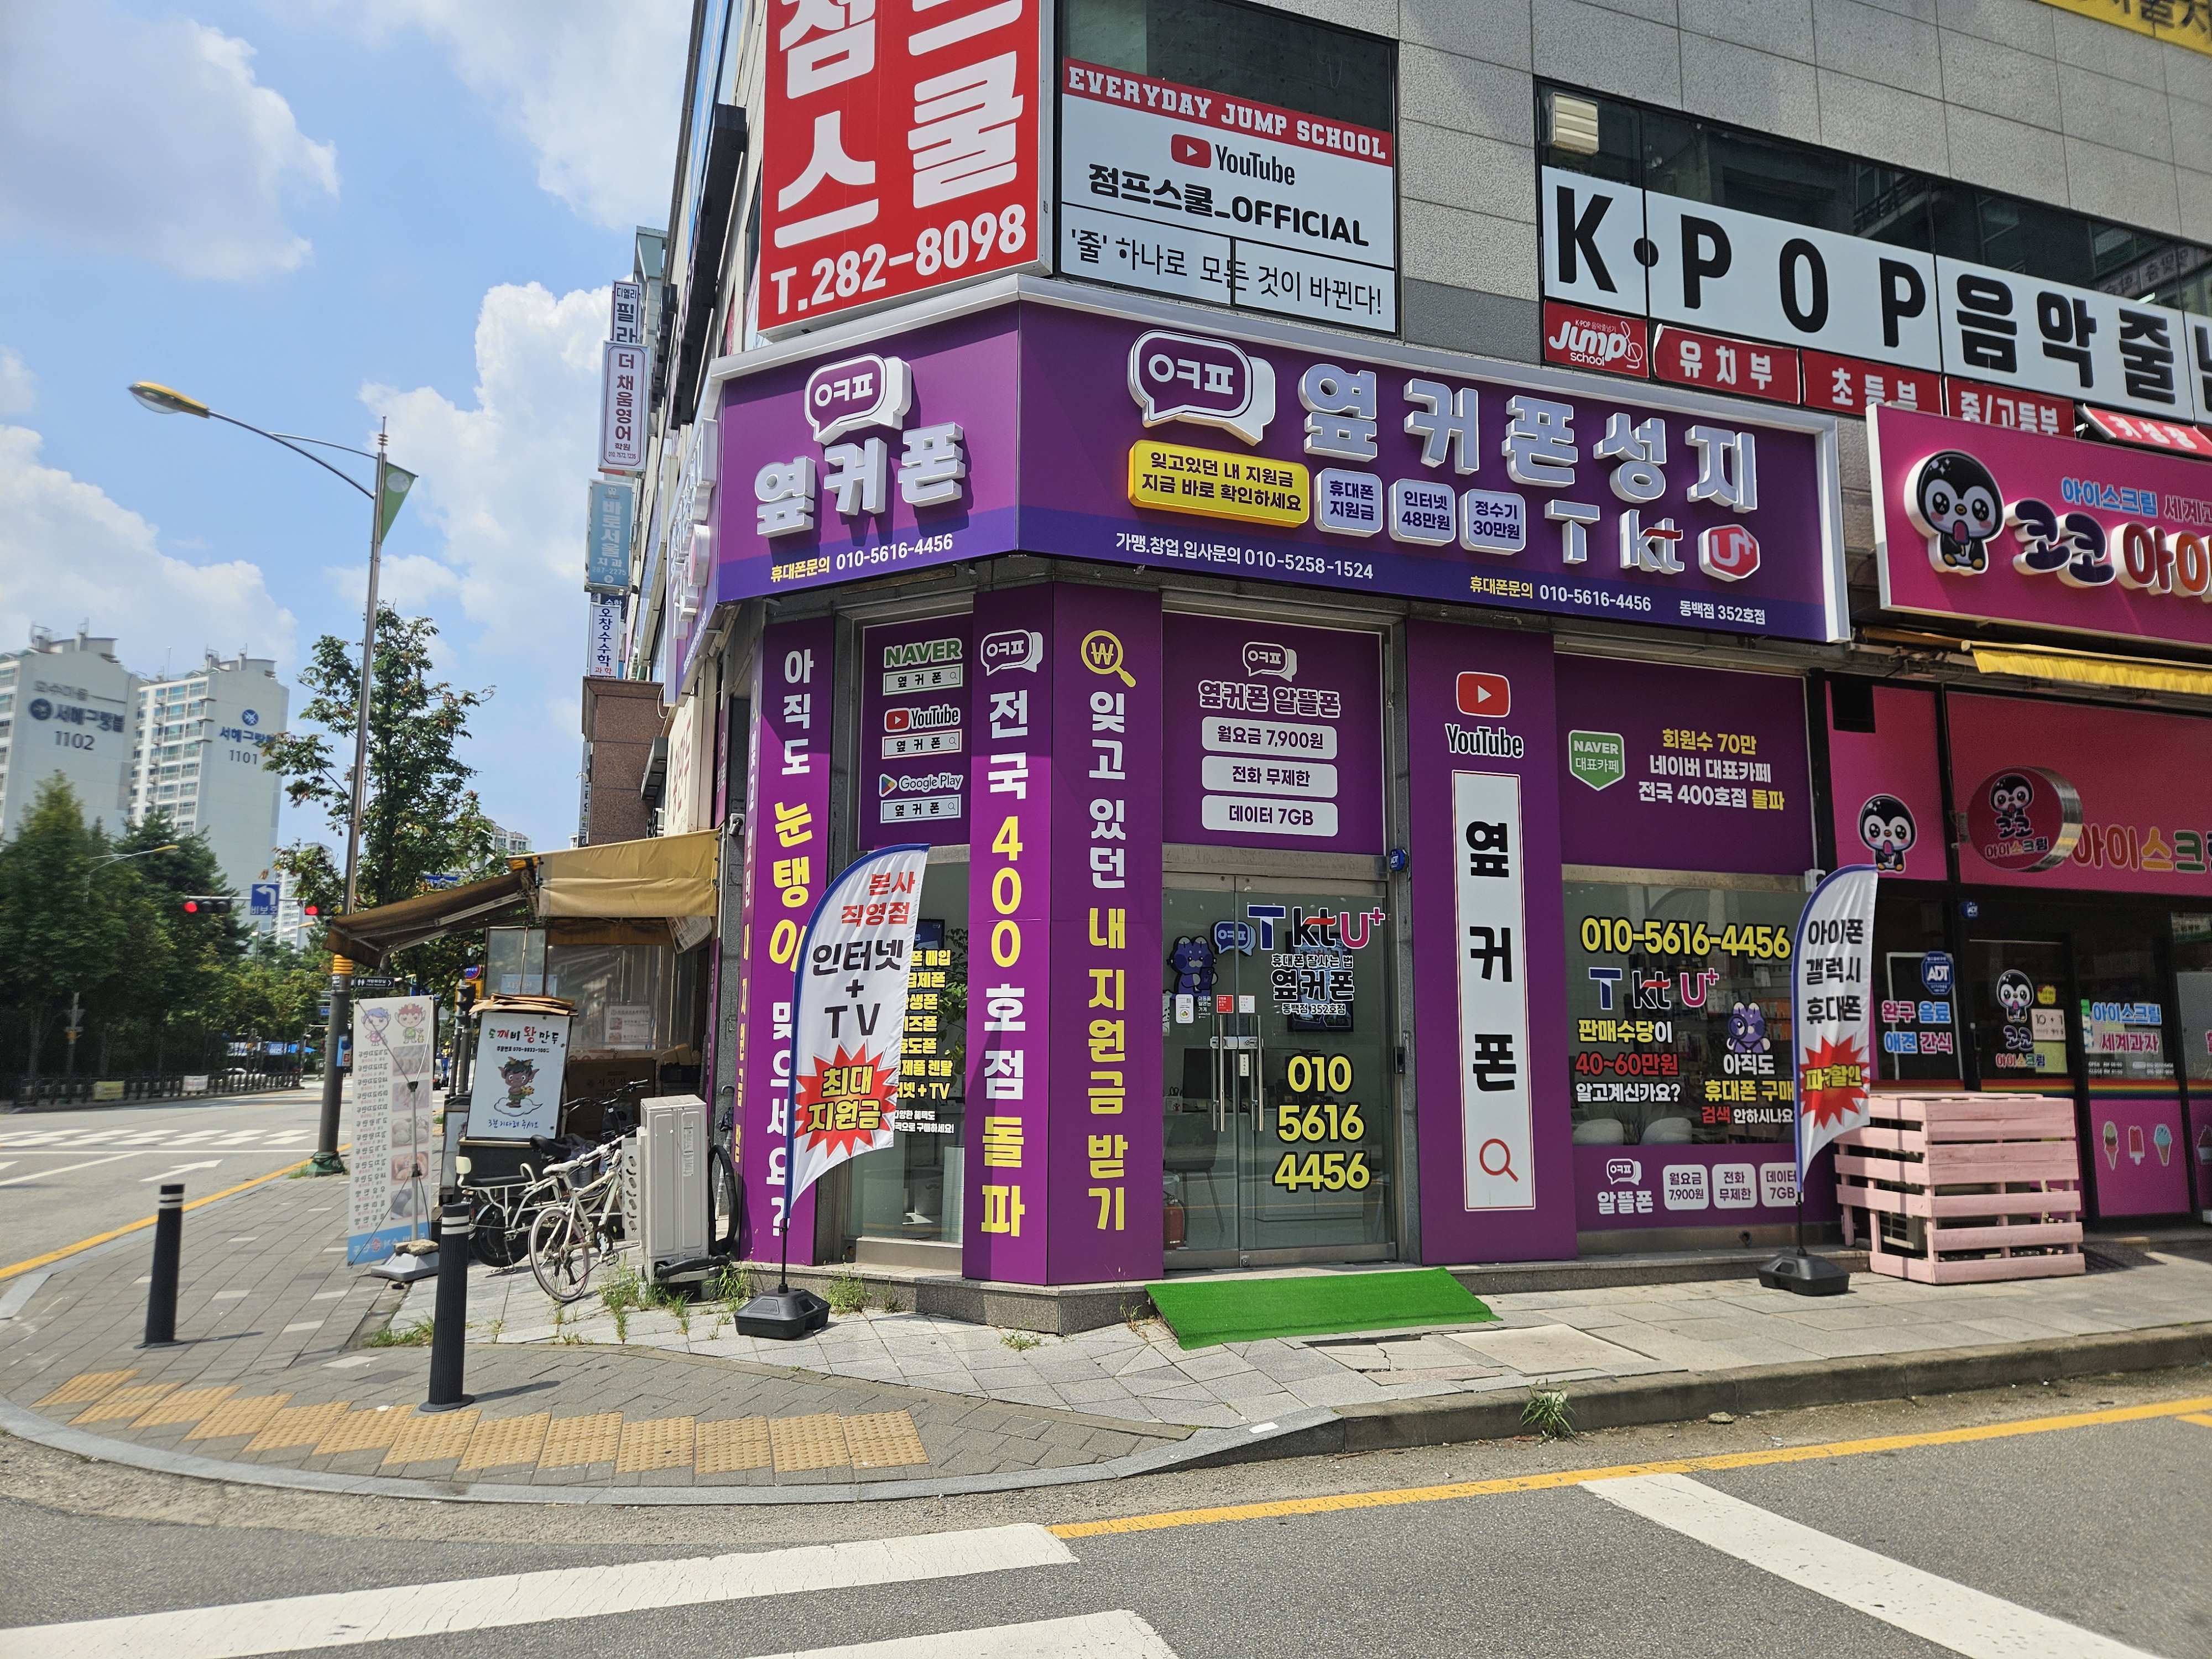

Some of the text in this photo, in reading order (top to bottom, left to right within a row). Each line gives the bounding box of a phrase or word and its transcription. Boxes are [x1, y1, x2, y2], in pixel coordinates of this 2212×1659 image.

[1068, 66, 1386, 159] EVERYDAY JUMP SCHOOL
[1215, 144, 1295, 185] YouTube
[1089, 164, 1369, 246] 점프스쿨_OFFICIAL
[771, 205, 1026, 315] T.282-8098
[1071, 229, 1382, 315] '줄' 하나로 모든 것이 바뀐다!
[1548, 321, 1626, 361] Jump
[1570, 352, 1605, 366] school
[1680, 340, 1917, 410] 유치부 초등부
[615, 353, 634, 441] 더 채움영어
[1961, 391, 2059, 435] 중/고등부
[1150, 451, 1293, 488] 잊고있던 내 지원금
[1142, 472, 1302, 513] 지금 바로 확인하세요
[1329, 481, 1374, 499] 휴대폰
[1404, 489, 1447, 510] 인터넷
[2062, 477, 2158, 518] 아이스크림
[1329, 502, 1374, 521] 지원금
[1401, 511, 1451, 531] 48만원
[1475, 499, 1518, 520] 정수기
[601, 500, 622, 557] 바로서울
[1473, 520, 1520, 540] 30만원
[1545, 499, 1600, 564] T
[1620, 509, 1685, 575] kt
[597, 559, 622, 568] 치과
[771, 533, 953, 582] 휴대폰문의 010-5616-4456
[1116, 532, 1373, 580] 가맹.창업.입사문의 010-5258-1524
[592, 566, 627, 576] 287-2275
[1470, 576, 1766, 625] 휴대폰문의 010-5616-4456 동백점 352호점
[886, 640, 961, 666] NAVER
[782, 649, 814, 775] 아직도
[1273, 686, 1341, 718] 알뜰폰
[911, 707, 958, 727] YouTube
[54, 731, 95, 750] 1102
[988, 689, 1029, 800] 전국
[1217, 725, 1323, 749] 월요금 7,900원
[1446, 723, 1524, 758] YouTube
[1574, 740, 1619, 754] NAVER
[1663, 728, 1756, 755] 회원수 70만
[230, 750, 258, 765] 1101
[1575, 757, 1619, 773] 대표카페
[1650, 755, 1771, 783] 네이버 대표카페
[900, 774, 961, 790] Google Play
[1232, 765, 1310, 787] 전화 무제한
[1639, 781, 1785, 811] 전국 400호점 돌파
[1229, 805, 1313, 825] 데이터 7GB
[1995, 816, 2033, 839] 코코
[1985, 836, 2048, 859] 아이스크림
[2072, 824, 2212, 873] 아이스크
[769, 802, 812, 973] 눈탱이
[870, 872, 915, 896] 본사
[251, 905, 278, 914] 비보호
[841, 902, 910, 927] 직영점
[1292, 907, 1337, 948] kt
[1582, 917, 1791, 958] 010-5616-4456
[1808, 919, 1864, 946] 아이폰
[813, 940, 903, 975] 인터넷
[925, 950, 951, 966] 매입
[1088, 691, 1128, 1230] 잊고 있던 내 지원금 받기
[1272, 953, 1353, 968] 휴대폰 잘사는 법
[1806, 957, 1861, 985] 갤럭시
[1927, 966, 1949, 980] ADT
[1632, 971, 1671, 1010] kt
[825, 1003, 880, 1039] TV
[1282, 1003, 1346, 1015] 동백점 352호점
[1807, 996, 1861, 1025] 휴대폰
[1882, 1000, 1952, 1024] 완구 음료
[2093, 1002, 2162, 1026] 아이스크림
[1578, 1020, 1672, 1043] 판매수당이
[1884, 1032, 1953, 1055] 애견 간식
[2004, 1025, 2033, 1051] 코코
[2101, 1031, 2158, 1053] 세계과자
[928, 1060, 953, 1077] 렌탈
[1575, 1053, 1679, 1076] 40~60만원
[1723, 1055, 1775, 1075] 아직도
[1996, 1053, 2045, 1068] 아이스크림
[822, 1065, 873, 1097] 최대
[1288, 1056, 1352, 1092] 010
[929, 1083, 950, 1099] TV
[1575, 1083, 1681, 1103] 알고계신가요?
[1705, 1079, 1757, 1102] 휴대폰
[807, 1099, 880, 1131] 지원금
[1279, 1104, 1365, 1141] 5616
[1702, 1106, 1730, 1124] 검색
[917, 1122, 954, 1134] 구매하세요!
[981, 1117, 1025, 1238] 돌파
[1275, 1153, 1370, 1190] 4456
[1669, 1172, 1702, 1185] 월요금
[1724, 1171, 1745, 1184] 전화
[1598, 1191, 1653, 1214] 알뜰폰
[1720, 1188, 1751, 1201] 무제한
